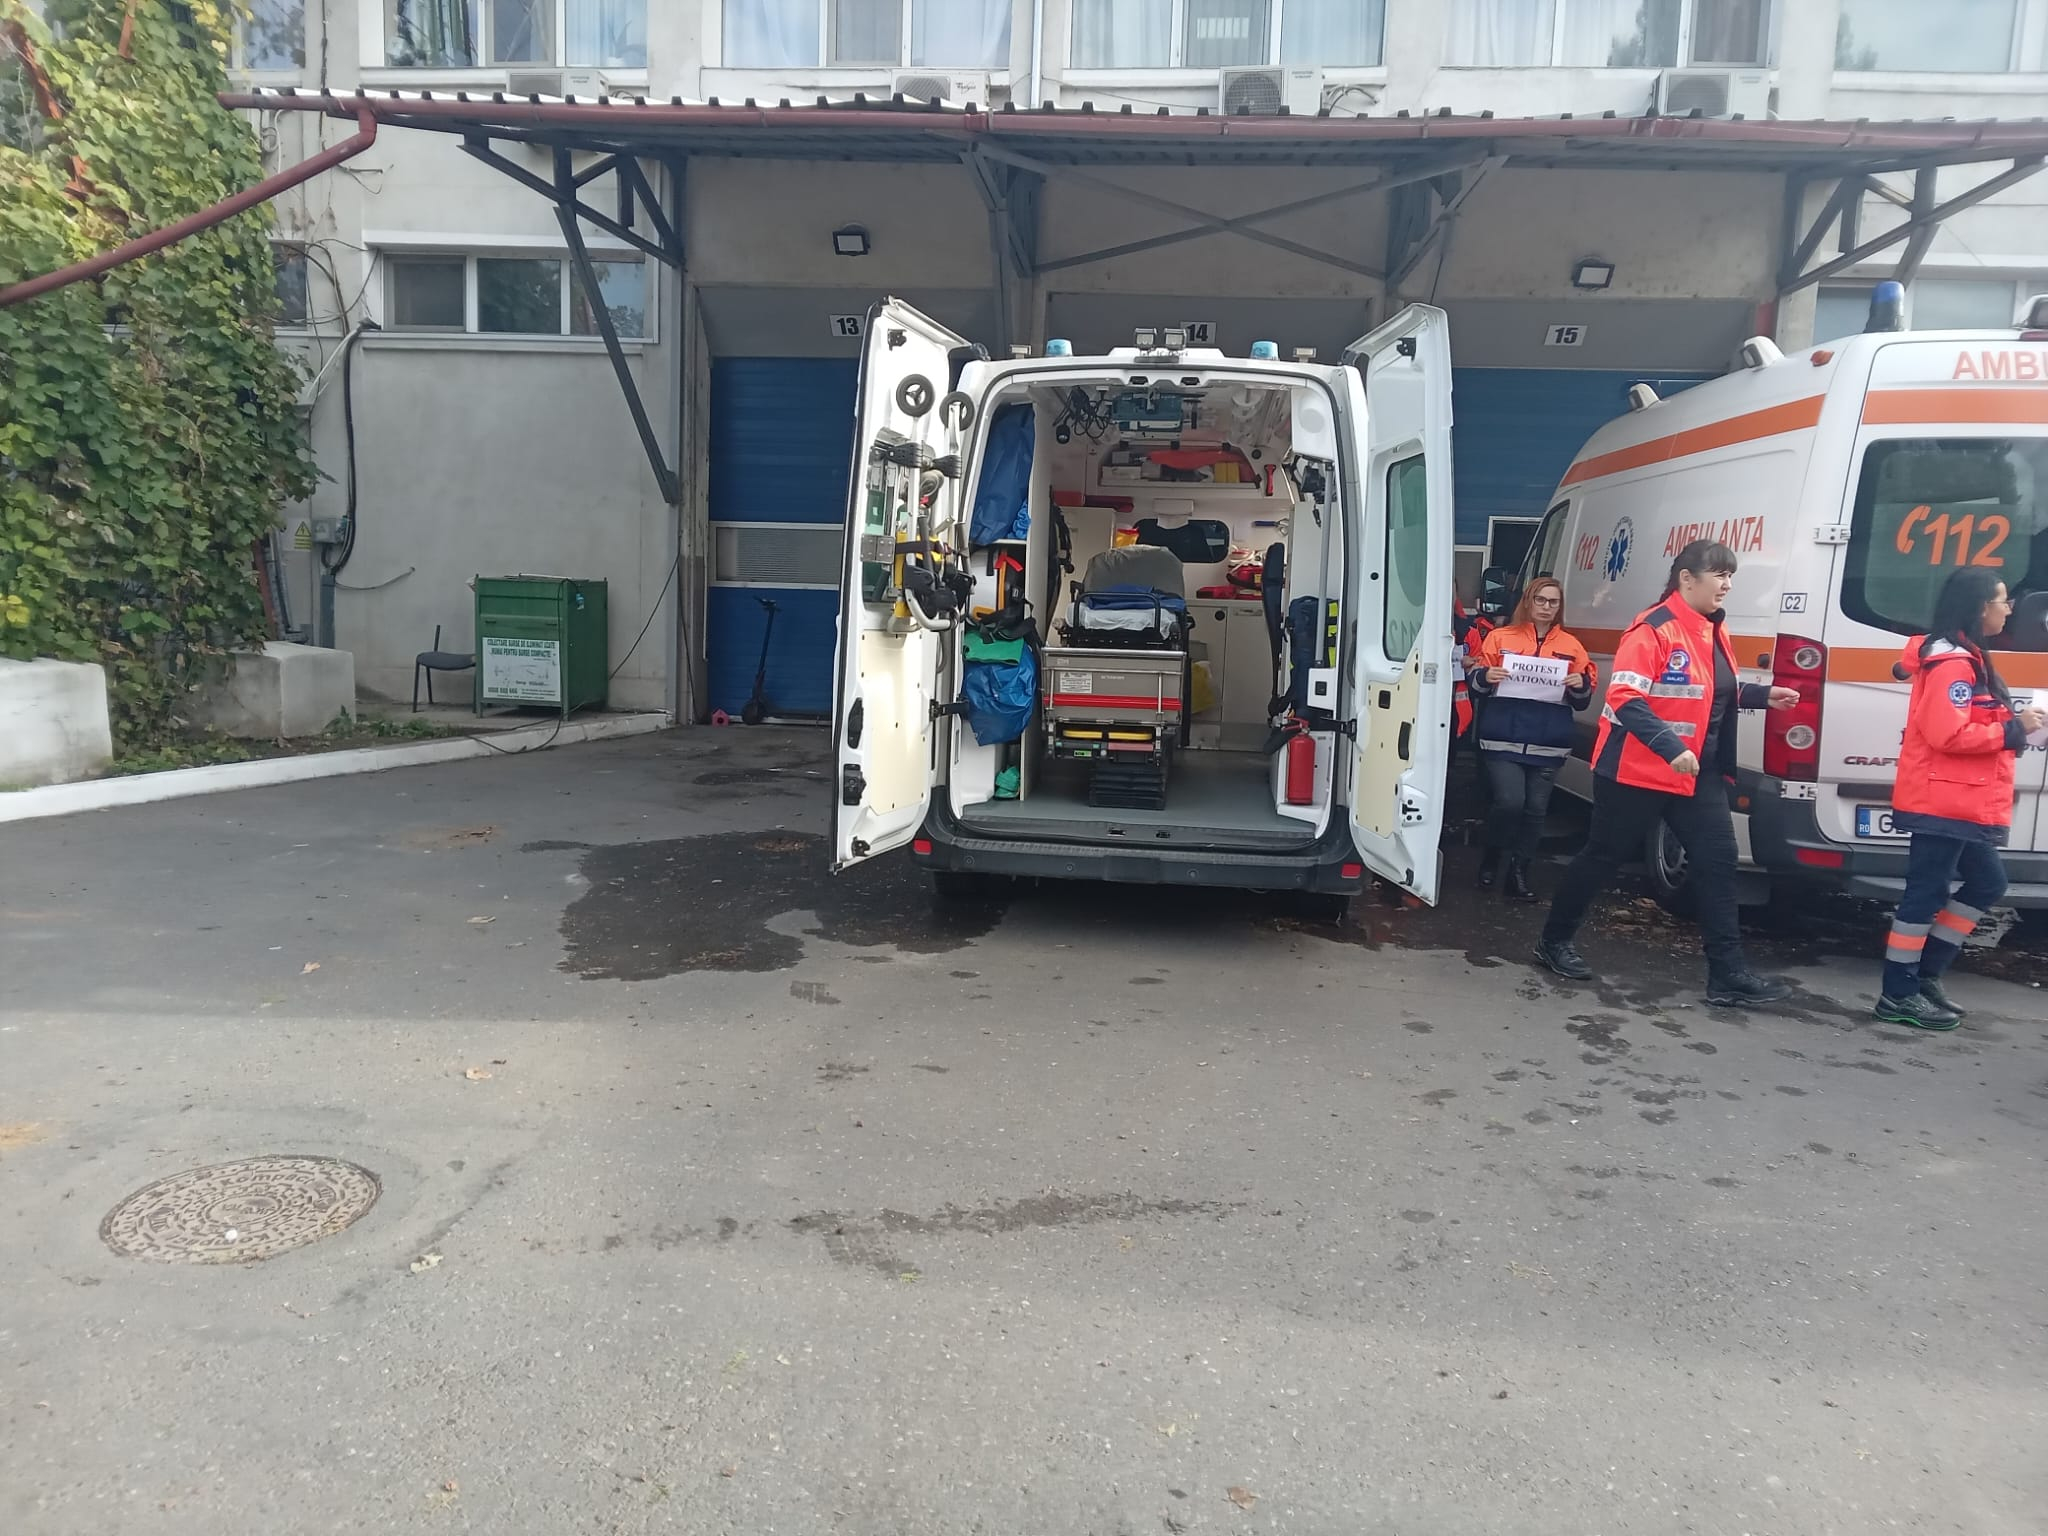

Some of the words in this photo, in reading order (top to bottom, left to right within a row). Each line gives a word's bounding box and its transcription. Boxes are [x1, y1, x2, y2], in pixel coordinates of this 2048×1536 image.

[837, 317, 859, 335] 13
[1187, 324, 1208, 341] 14
[1555, 327, 1579, 344] 15
[1952, 351, 2048, 380] AMB
[1932, 513, 2011, 567] 112
[1579, 535, 1600, 571] 112
[1785, 596, 1801, 610] C2
[1512, 662, 1560, 675] PROTEST
[1506, 675, 1561, 687] NATIONAL
[1859, 824, 1870, 833] RO
